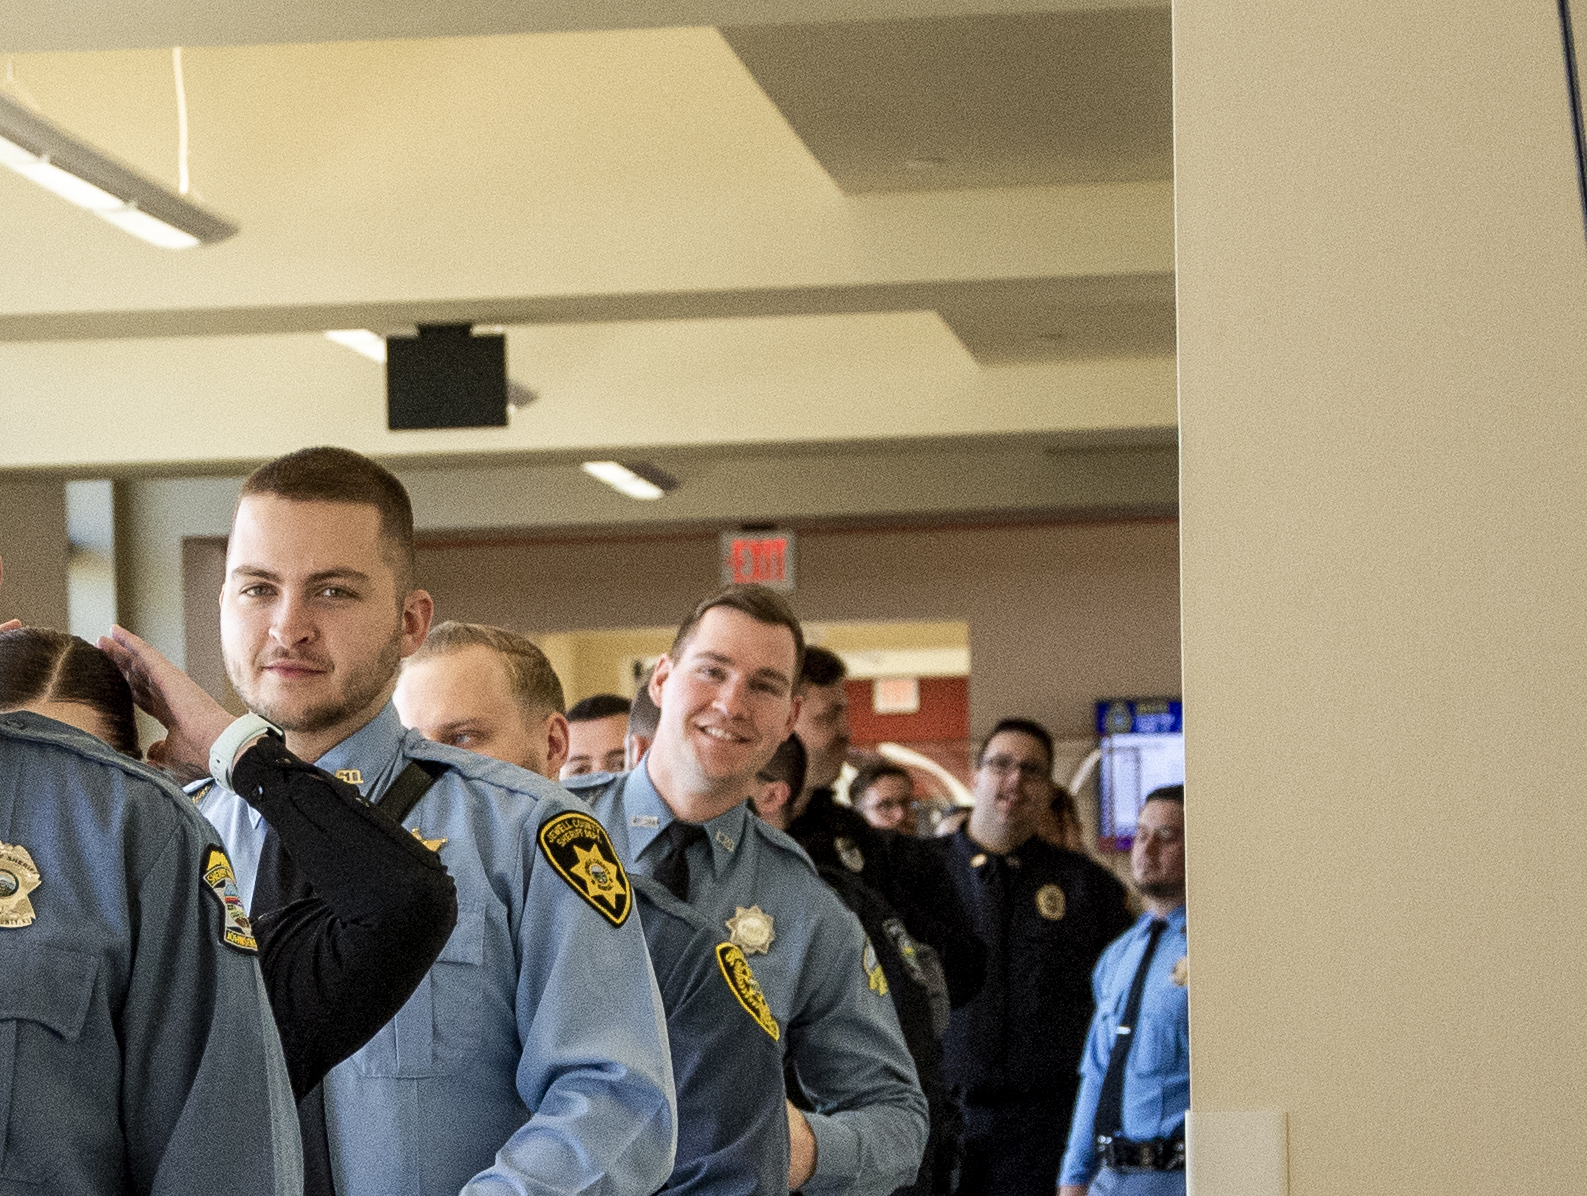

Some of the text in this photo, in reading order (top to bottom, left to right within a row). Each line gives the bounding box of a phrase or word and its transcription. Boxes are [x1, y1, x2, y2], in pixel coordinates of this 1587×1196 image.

[732, 538, 786, 583] EXIT
[547, 820, 573, 843] JEWELL
[556, 828, 583, 847] SHERIFF
